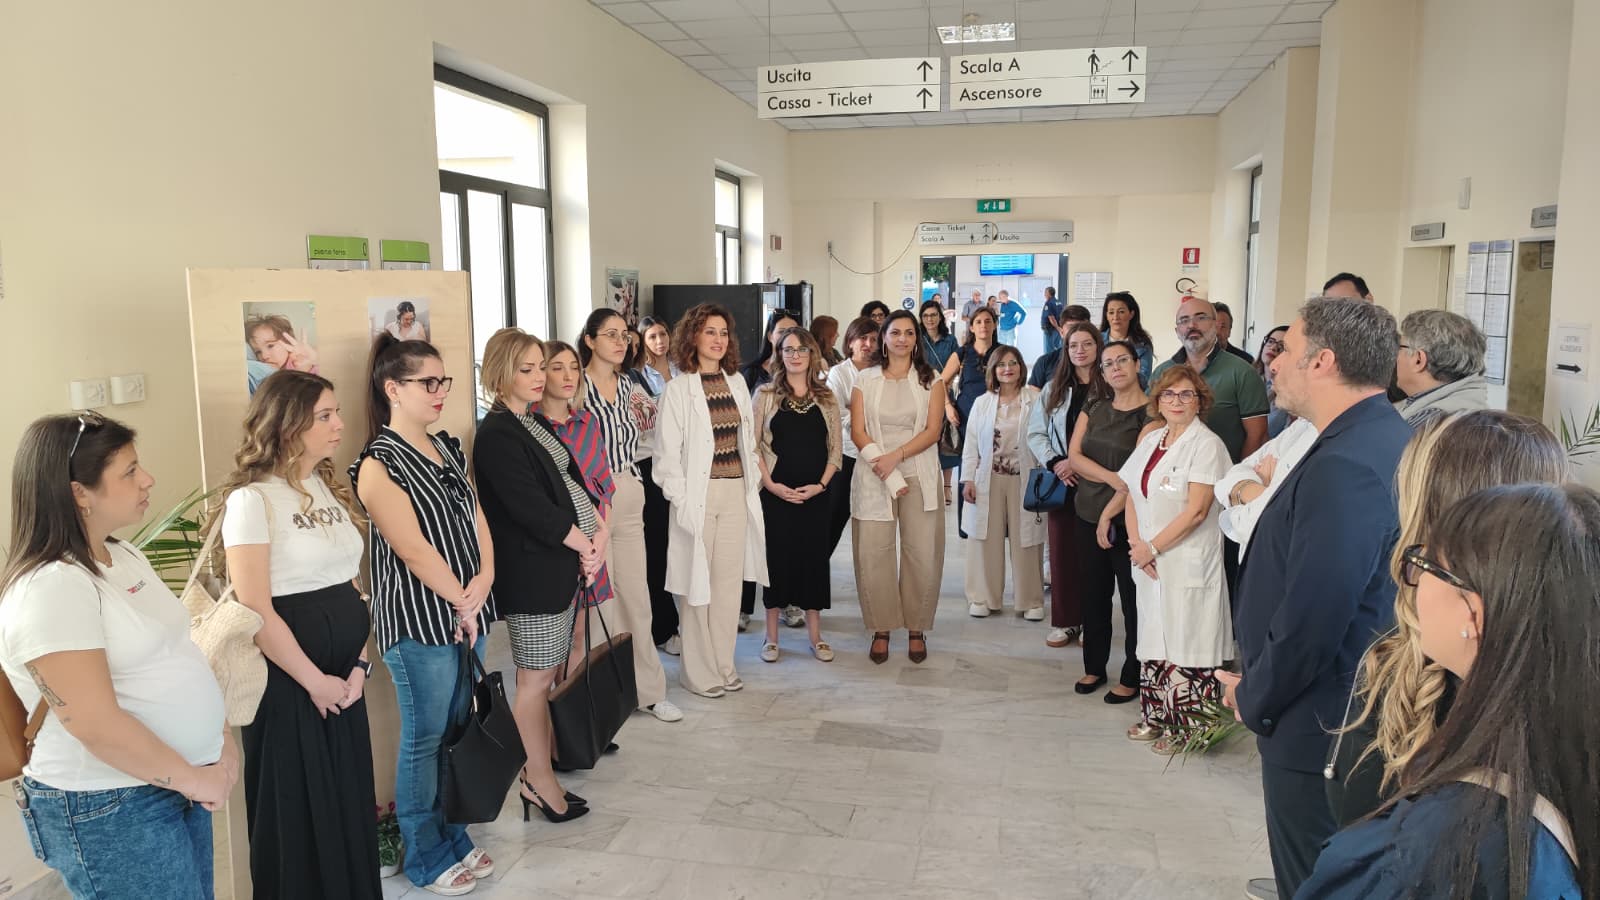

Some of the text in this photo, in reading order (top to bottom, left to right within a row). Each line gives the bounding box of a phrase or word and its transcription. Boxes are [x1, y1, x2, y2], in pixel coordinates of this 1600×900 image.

[959, 57, 1021, 75] Scala A
[767, 68, 812, 84] Uscita
[767, 96, 812, 111] Cassa
[827, 91, 873, 107] Ticket
[959, 86, 1043, 102] Ascensore
[947, 224, 966, 232] Ticket
